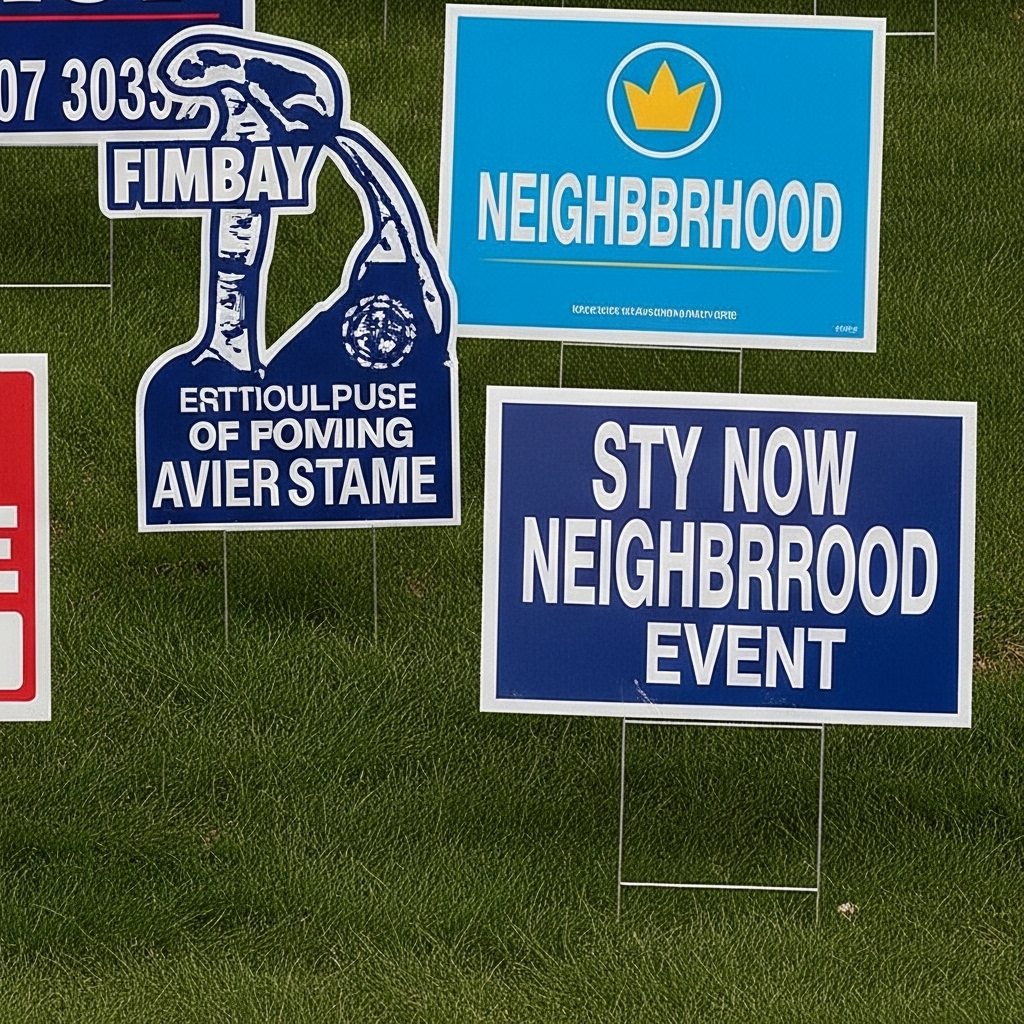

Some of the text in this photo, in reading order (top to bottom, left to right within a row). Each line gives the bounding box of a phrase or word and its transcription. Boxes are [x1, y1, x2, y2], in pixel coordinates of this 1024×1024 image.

[113, 146, 314, 204] FIMBAY
[477, 171, 843, 253] NEIGHBBRHOOD
[188, 421, 240, 452] OF
[592, 420, 857, 516] STY NOW
[152, 456, 437, 509] AVIER STAME
[522, 516, 938, 616] NEIGHBRROOD
[646, 622, 847, 690] EVENT
